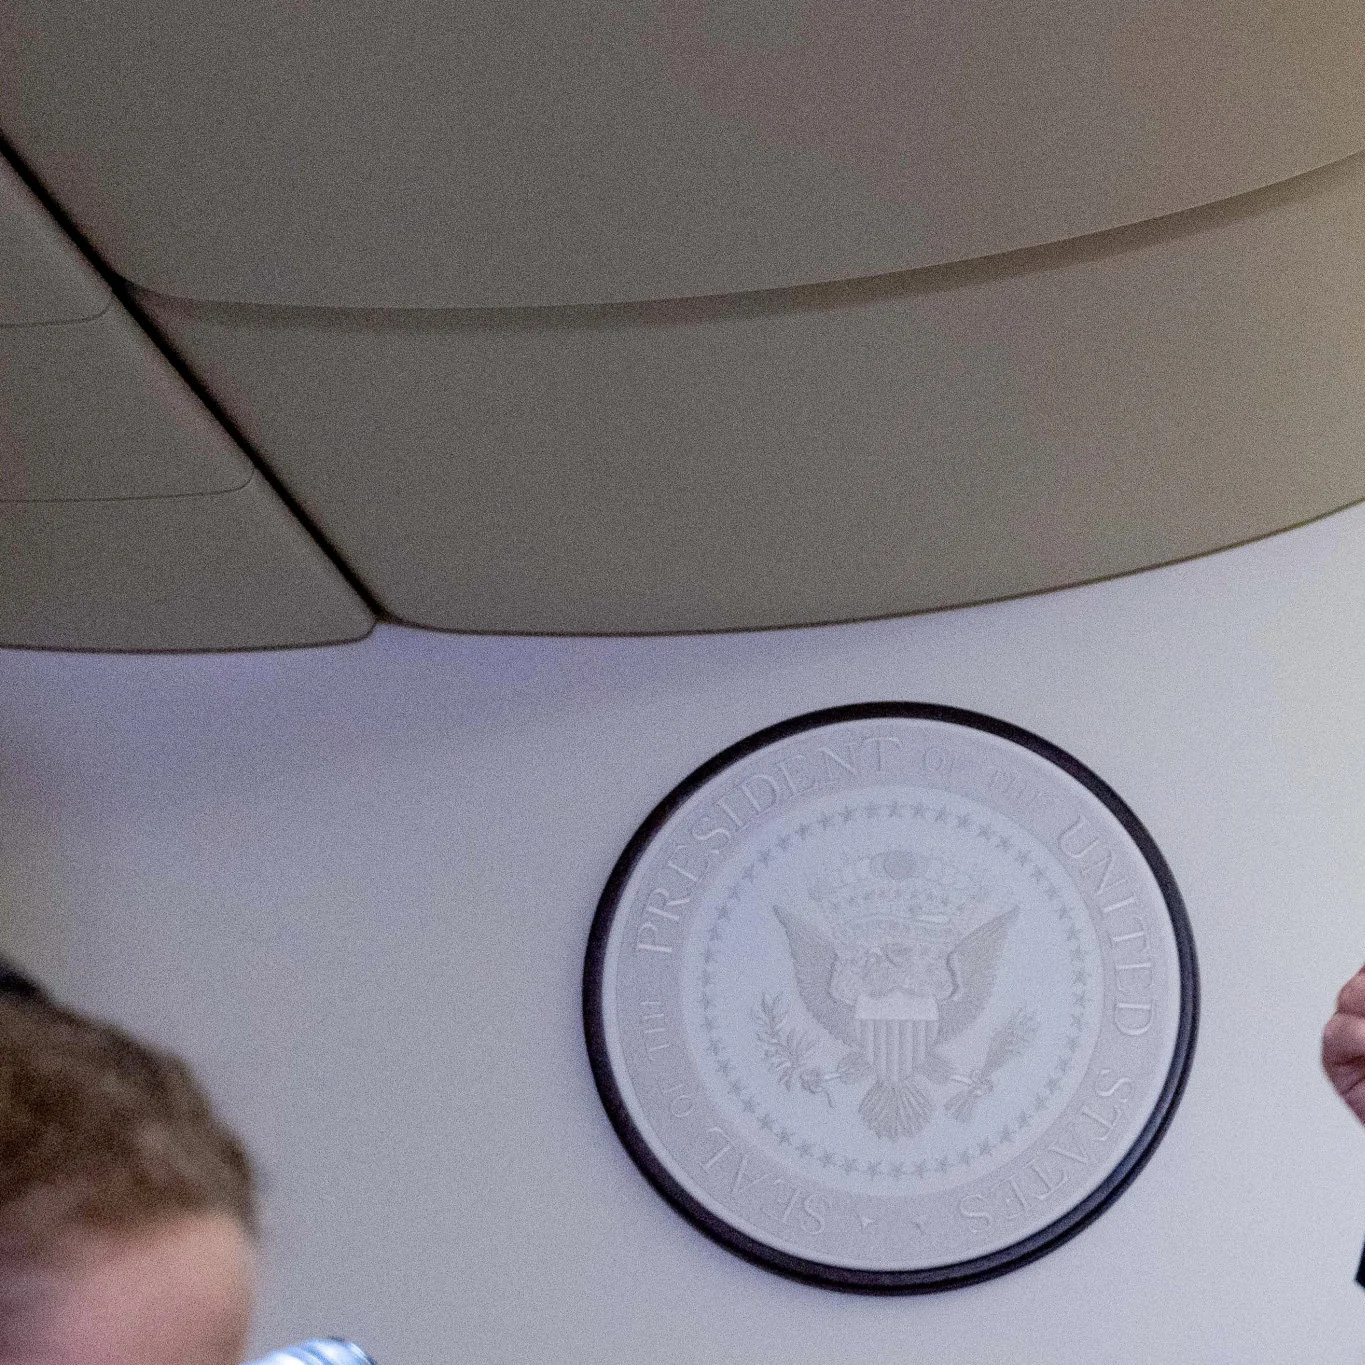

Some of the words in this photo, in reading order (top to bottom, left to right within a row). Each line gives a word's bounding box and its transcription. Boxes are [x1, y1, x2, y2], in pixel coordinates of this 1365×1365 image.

[636, 736, 902, 954] PRESIDENT
[1057, 815, 1154, 1037] UNITED
[702, 1126, 829, 1236] SEAL
[959, 1066, 1134, 1235] STATES
